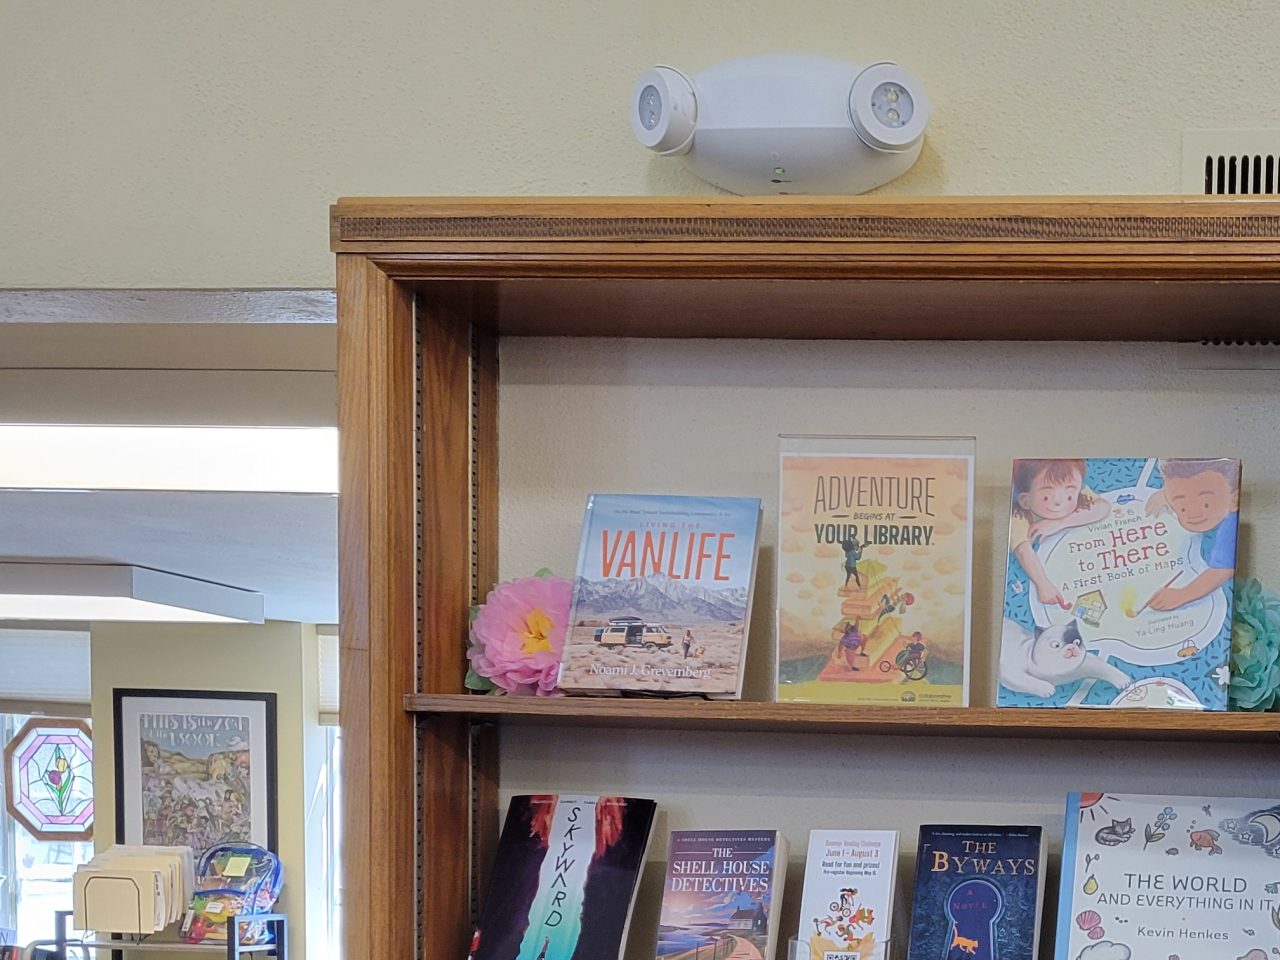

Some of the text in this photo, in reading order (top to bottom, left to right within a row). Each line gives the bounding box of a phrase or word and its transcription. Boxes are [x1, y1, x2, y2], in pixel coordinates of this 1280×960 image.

[814, 475, 936, 517] ADVENTURE
[853, 512, 883, 520] BEGINS
[814, 524, 858, 545] YOUR
[1087, 522, 1113, 533] Vivian
[1069, 521, 1169, 553] From Here
[602, 529, 736, 580] VANLIFE
[1078, 541, 1170, 572] to There
[1062, 556, 1184, 591] A First Book of Maps
[590, 664, 711, 680] Noami J. Grevemberg
[712, 848, 734, 857] THE
[825, 849, 840, 857] June
[851, 849, 873, 859] August
[874, 849, 879, 857] 3
[962, 841, 996, 854] THE
[545, 807, 582, 927] SKYWARD
[672, 861, 769, 874] SHELL HOUSE
[930, 851, 1036, 876] BYWAYS
[671, 877, 768, 892] DETECTIVES
[1124, 873, 1248, 893] THE WORLD
[1097, 893, 1274, 911] AND EVERYTHING IN IT
[1137, 926, 1230, 940] Kevin Henkes
